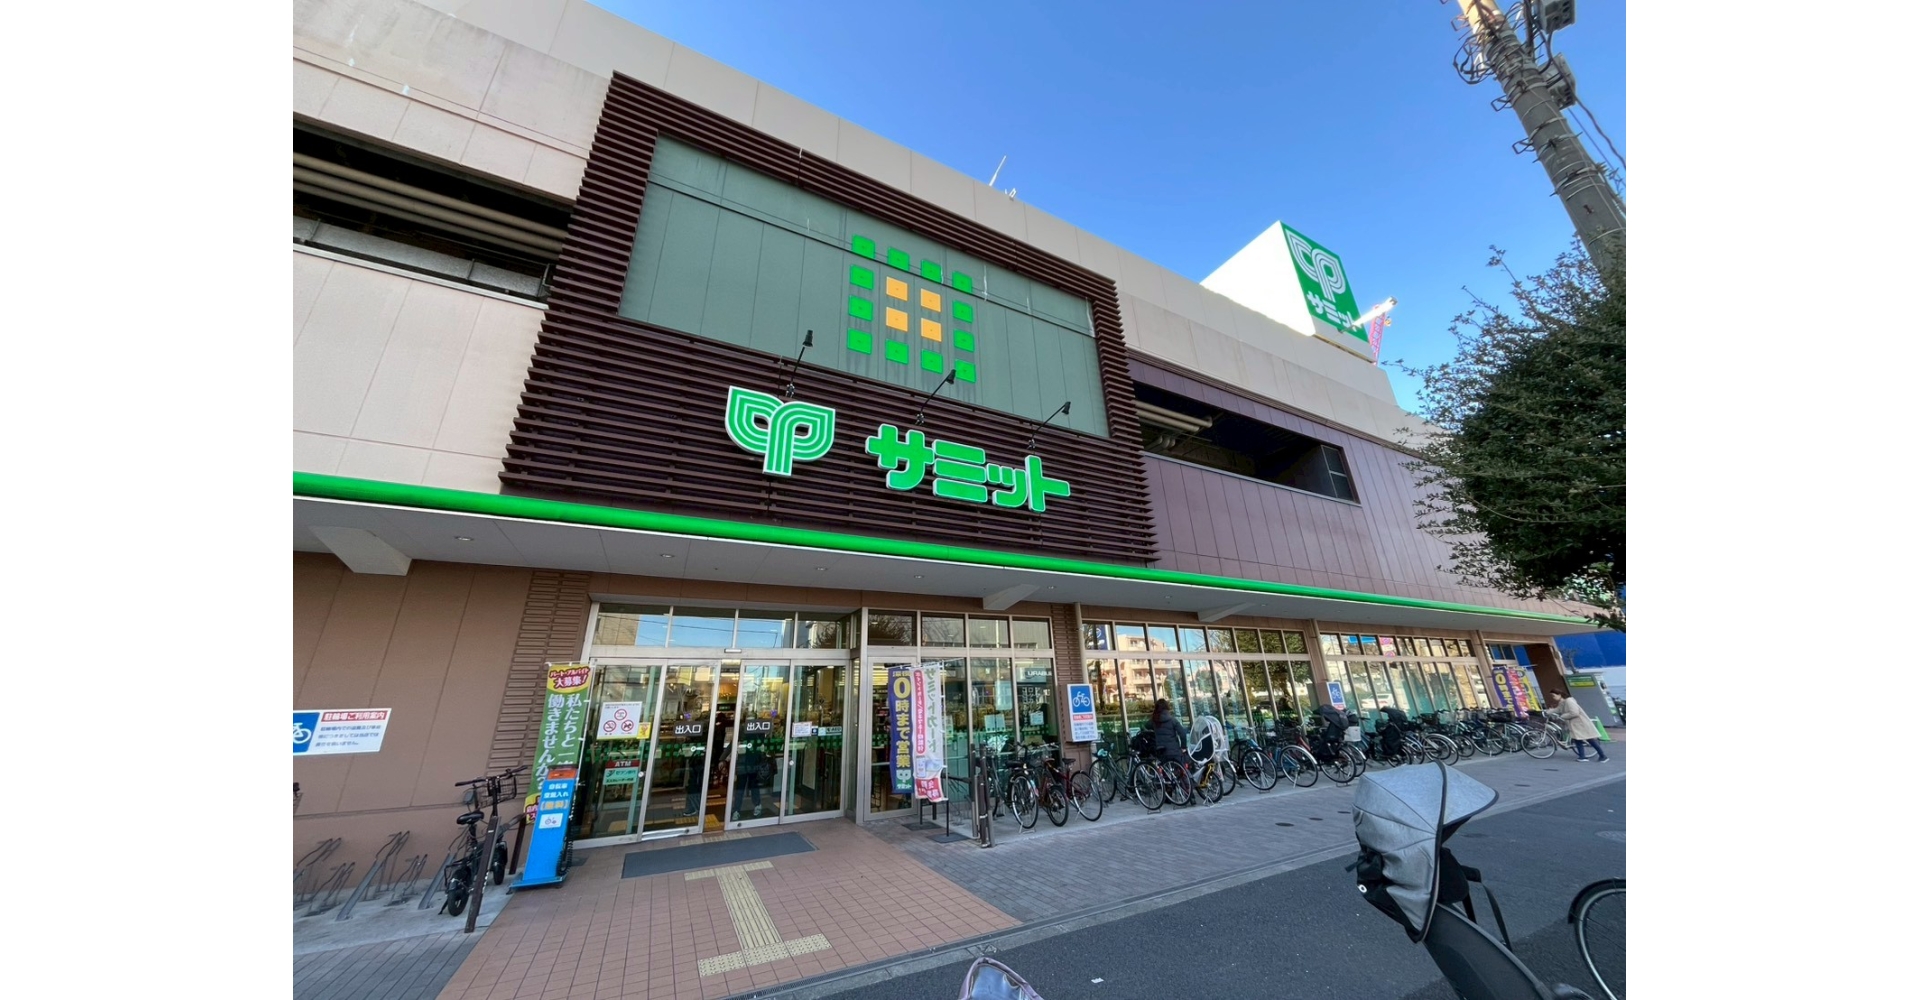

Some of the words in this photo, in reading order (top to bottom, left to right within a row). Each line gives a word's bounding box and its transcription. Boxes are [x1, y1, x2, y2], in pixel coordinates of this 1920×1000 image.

[865, 423, 1071, 512] サミット
[558, 693, 582, 765] 私たちと一
[675, 724, 701, 735] 出入口
[746, 721, 770, 731] 出入口
[925, 668, 938, 753] サミットカード
